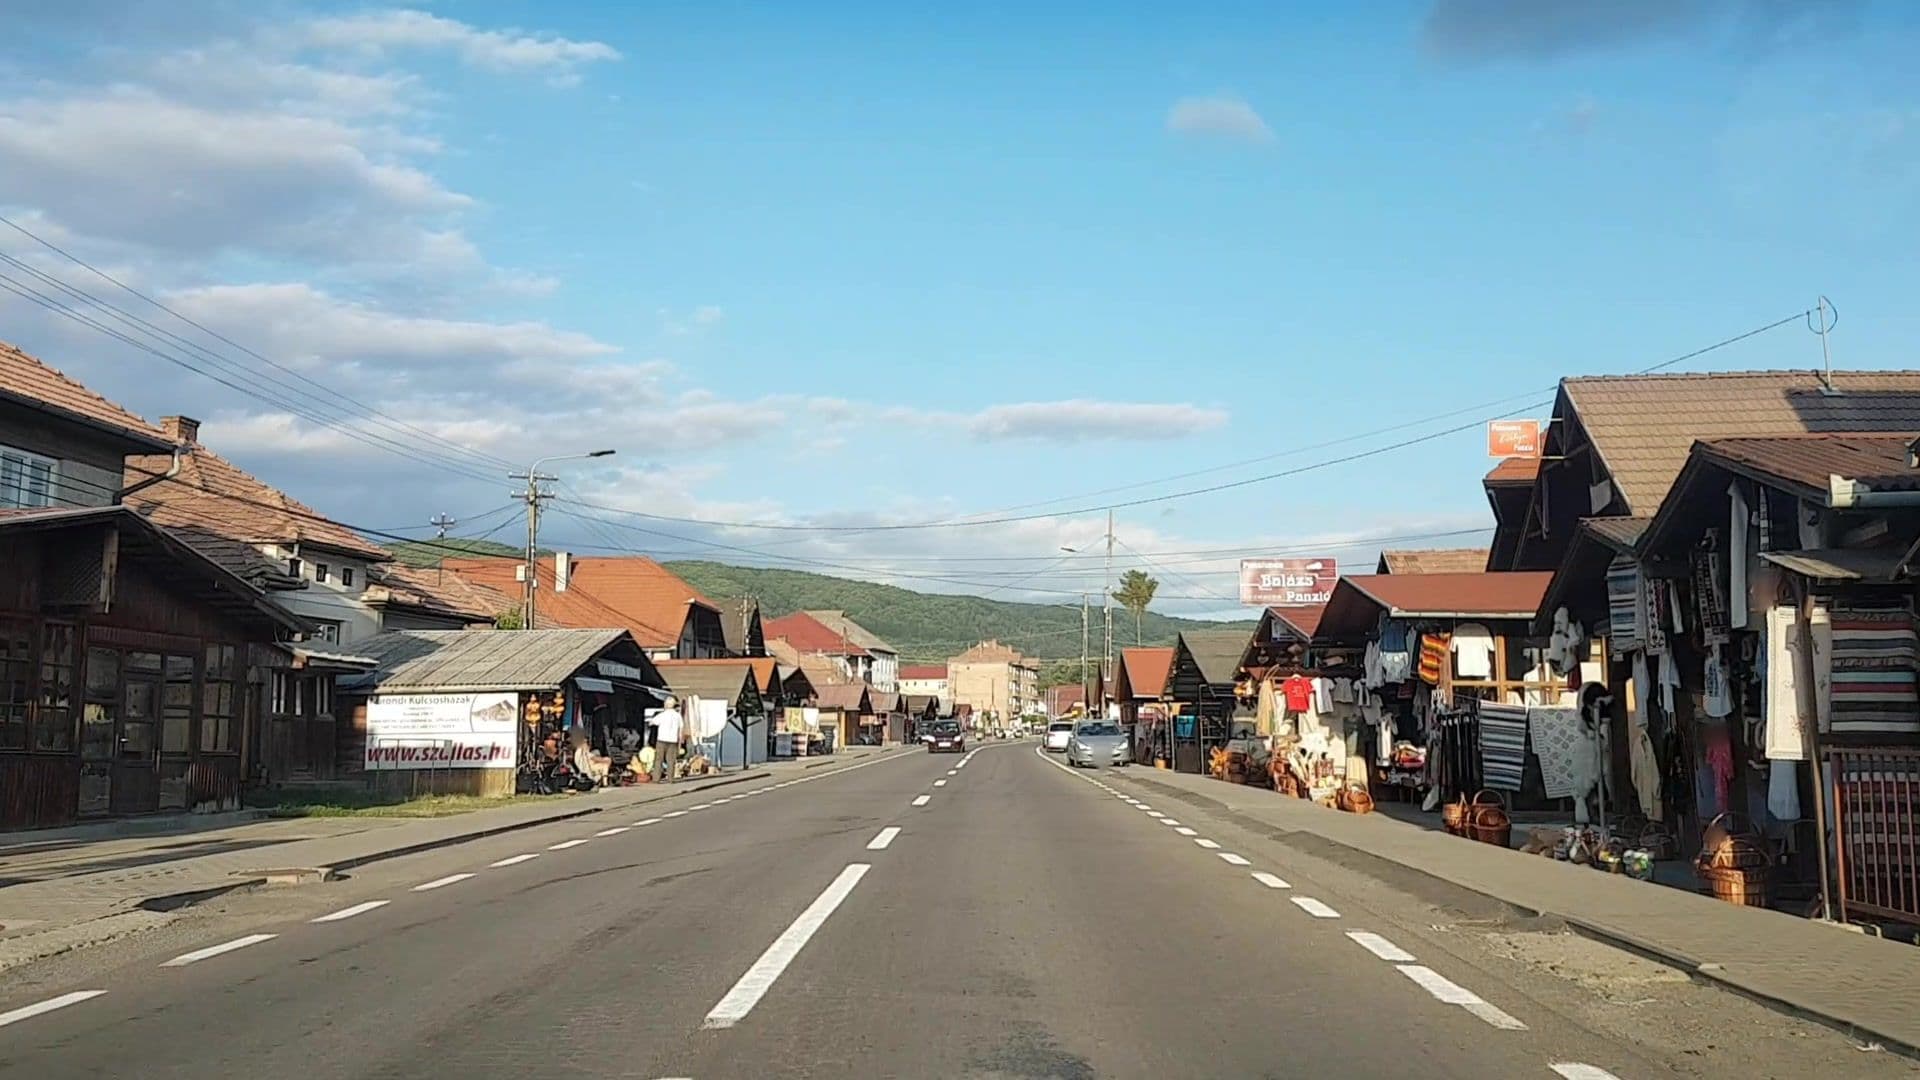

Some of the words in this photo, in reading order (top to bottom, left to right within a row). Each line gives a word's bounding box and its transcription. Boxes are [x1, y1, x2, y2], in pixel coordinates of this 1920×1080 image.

[1261, 574, 1314, 587] Balázs
[1286, 590, 1331, 602] Panzió
[369, 696, 407, 705] rondi
